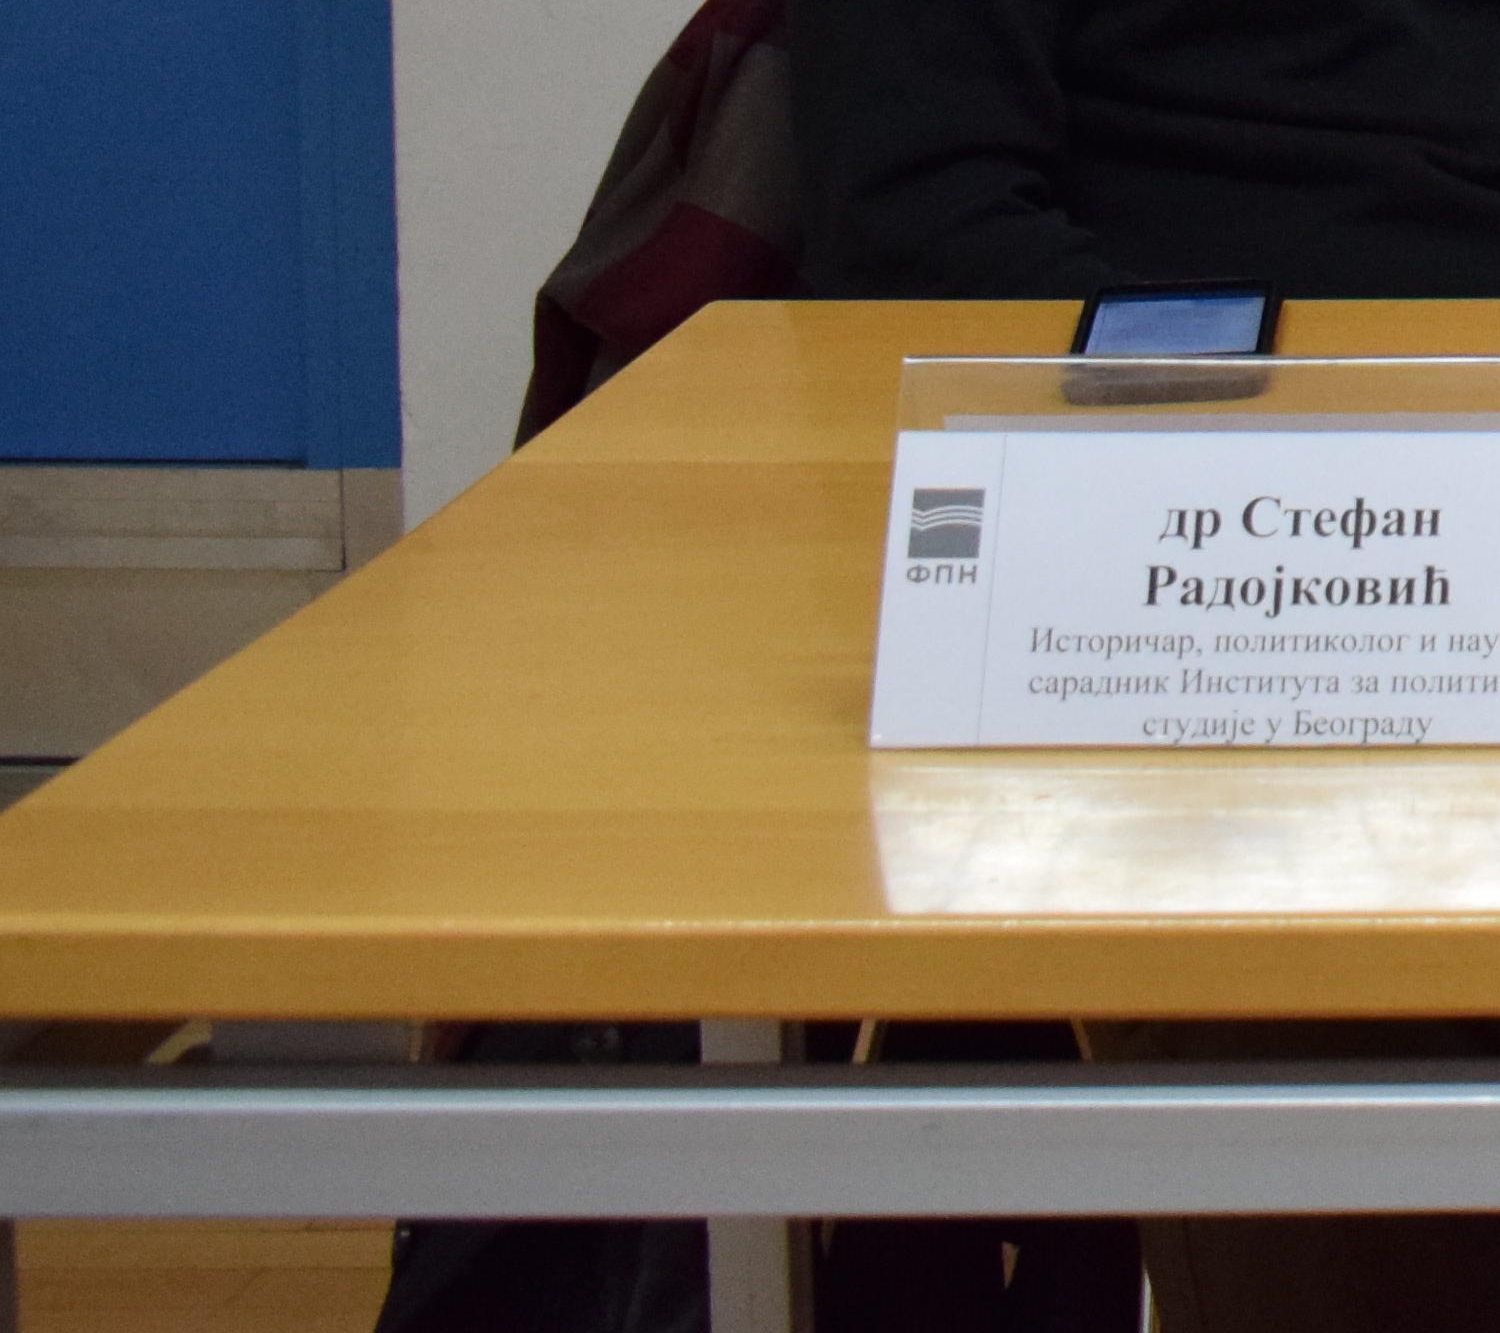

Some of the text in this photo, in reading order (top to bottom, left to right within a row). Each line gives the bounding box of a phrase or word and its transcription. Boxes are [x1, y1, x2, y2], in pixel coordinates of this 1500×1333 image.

[1159, 497, 1440, 550] др Стефан
[906, 564, 977, 584] ФПН
[1145, 565, 1449, 618] Радојковић
[1030, 627, 1202, 661] Историчар,
[1214, 634, 1404, 653] политиколог
[1420, 634, 1436, 652] и
[1028, 676, 1169, 702] сарадник
[1180, 668, 1339, 701] Института
[1352, 675, 1379, 694] за
[1142, 710, 1434, 744] студије у Београду
